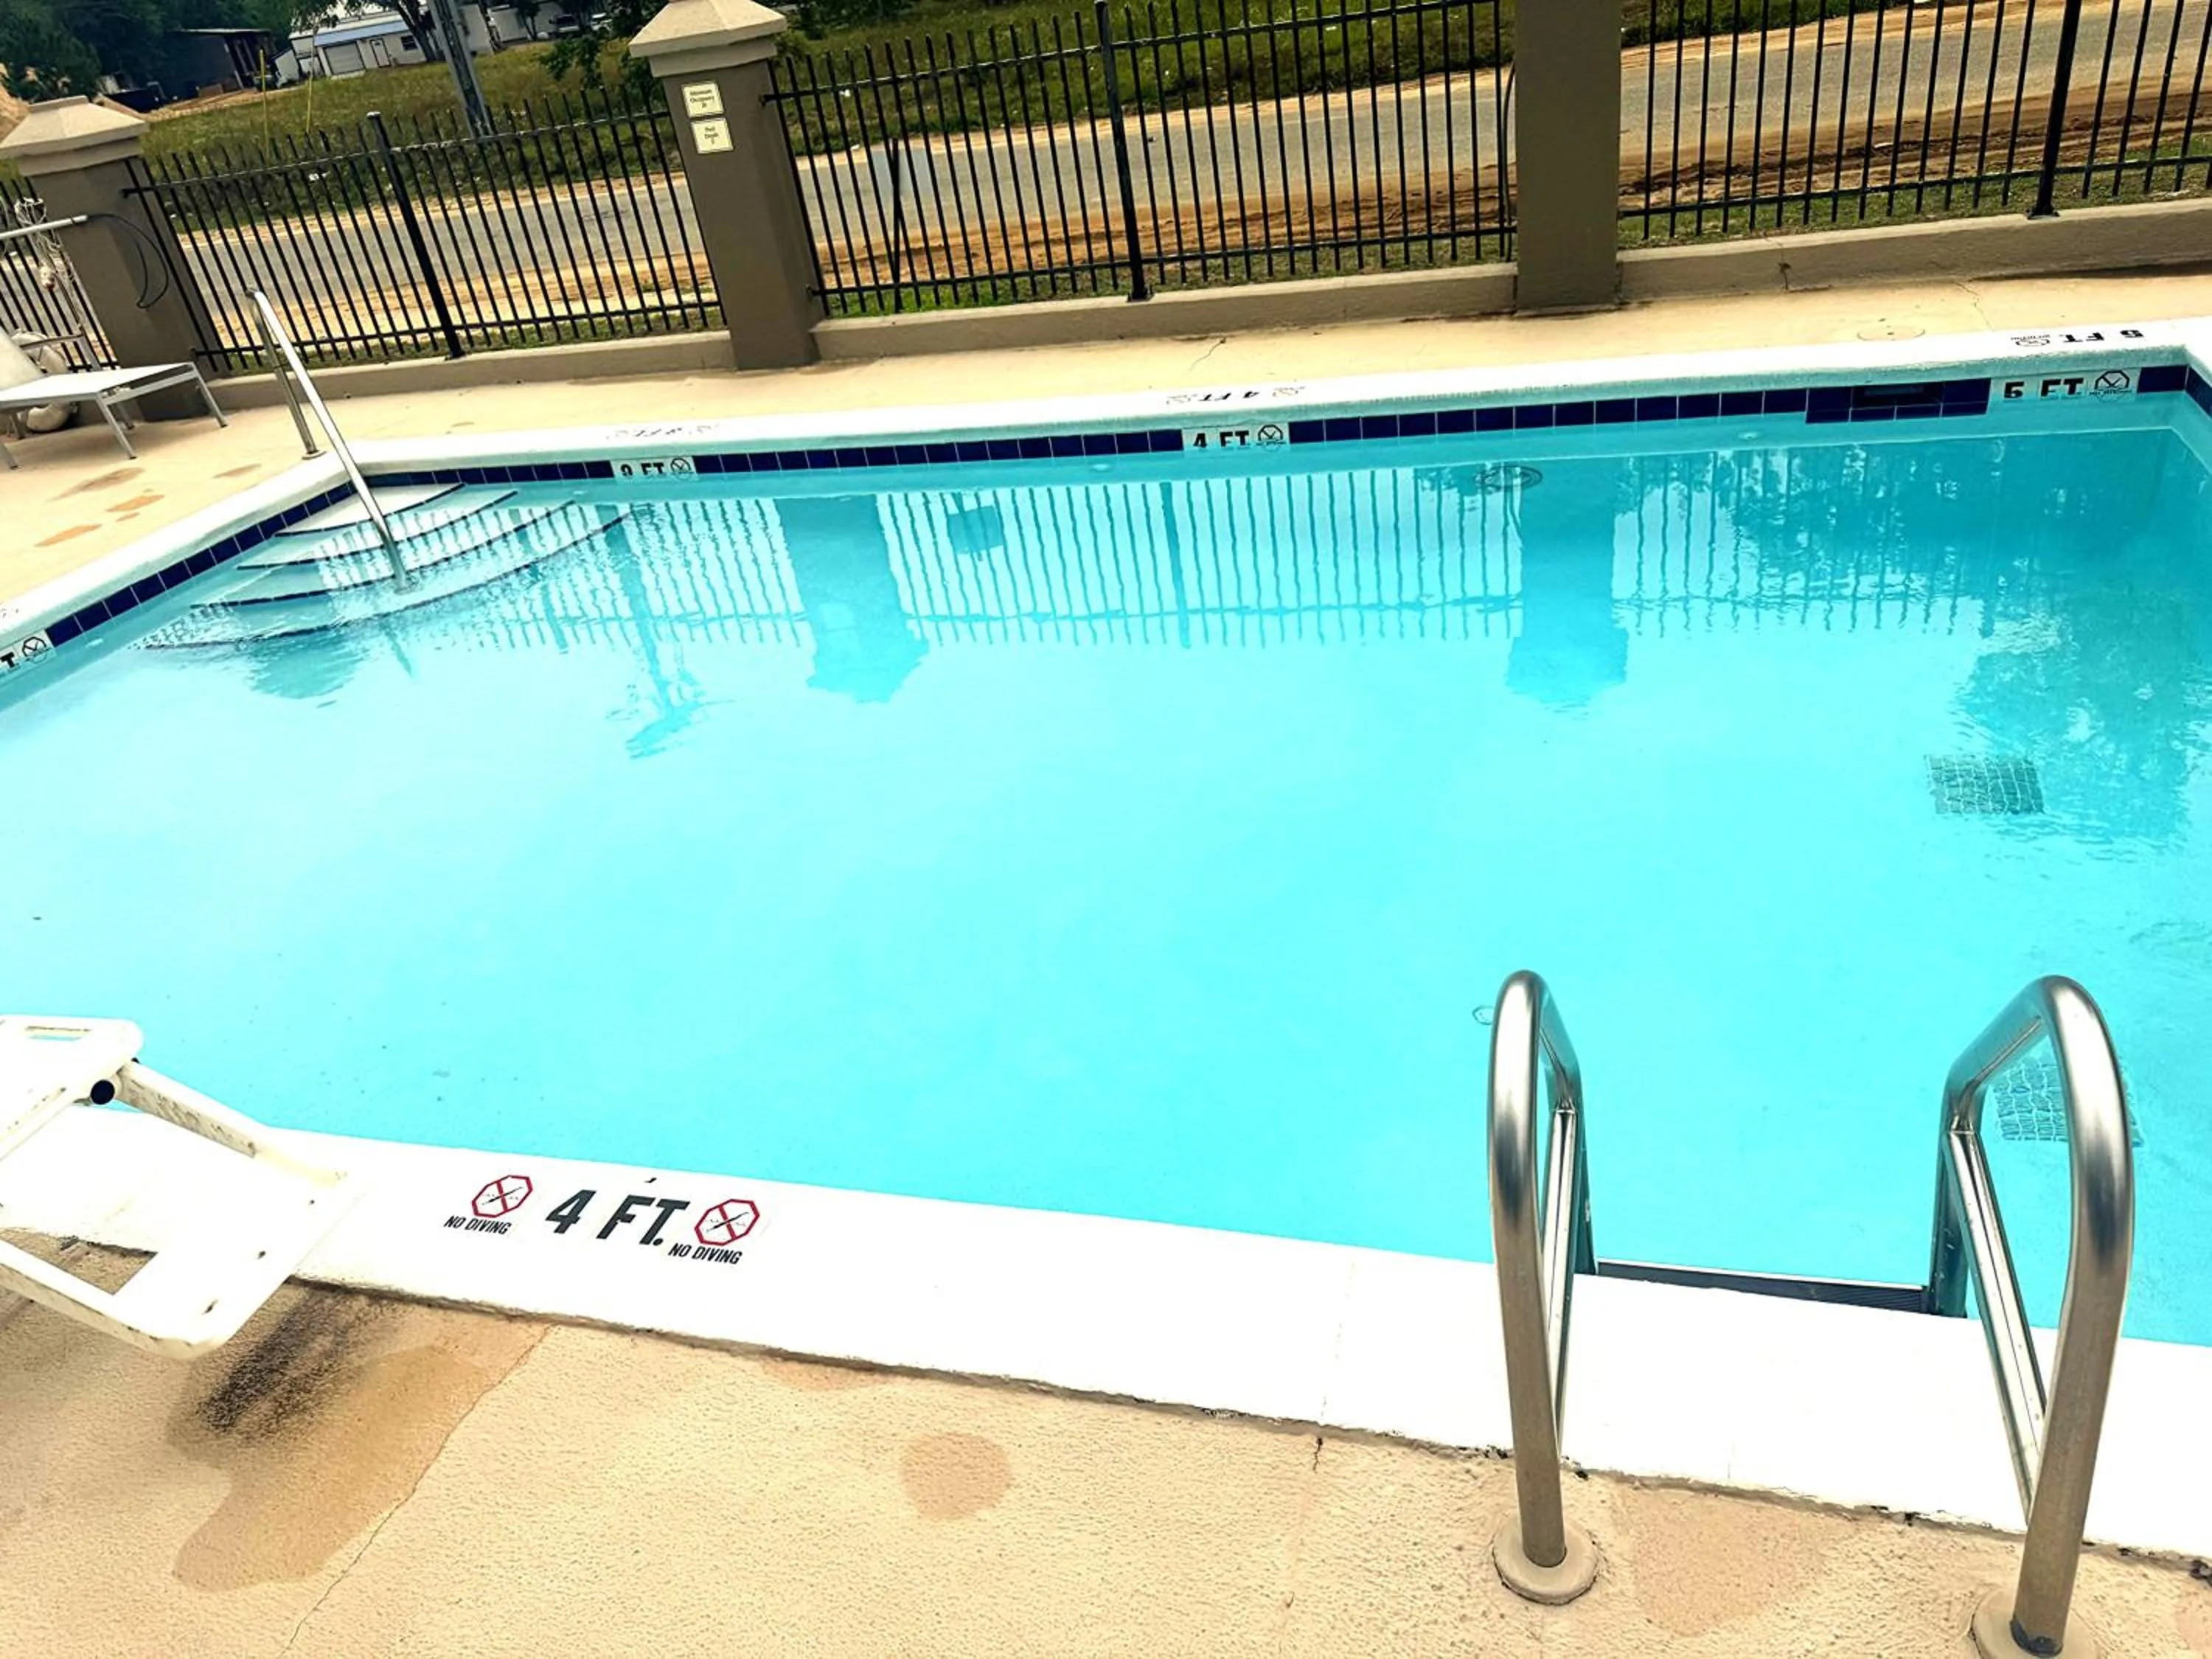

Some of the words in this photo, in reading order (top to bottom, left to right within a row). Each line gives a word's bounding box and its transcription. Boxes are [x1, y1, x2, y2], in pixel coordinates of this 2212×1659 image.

[443, 1214, 467, 1228] NO
[465, 1217, 512, 1234] DIVING
[545, 1189, 597, 1234] 4
[596, 1194, 691, 1246] FT.
[667, 1242, 692, 1257] NO
[692, 1245, 742, 1265] DIVING
